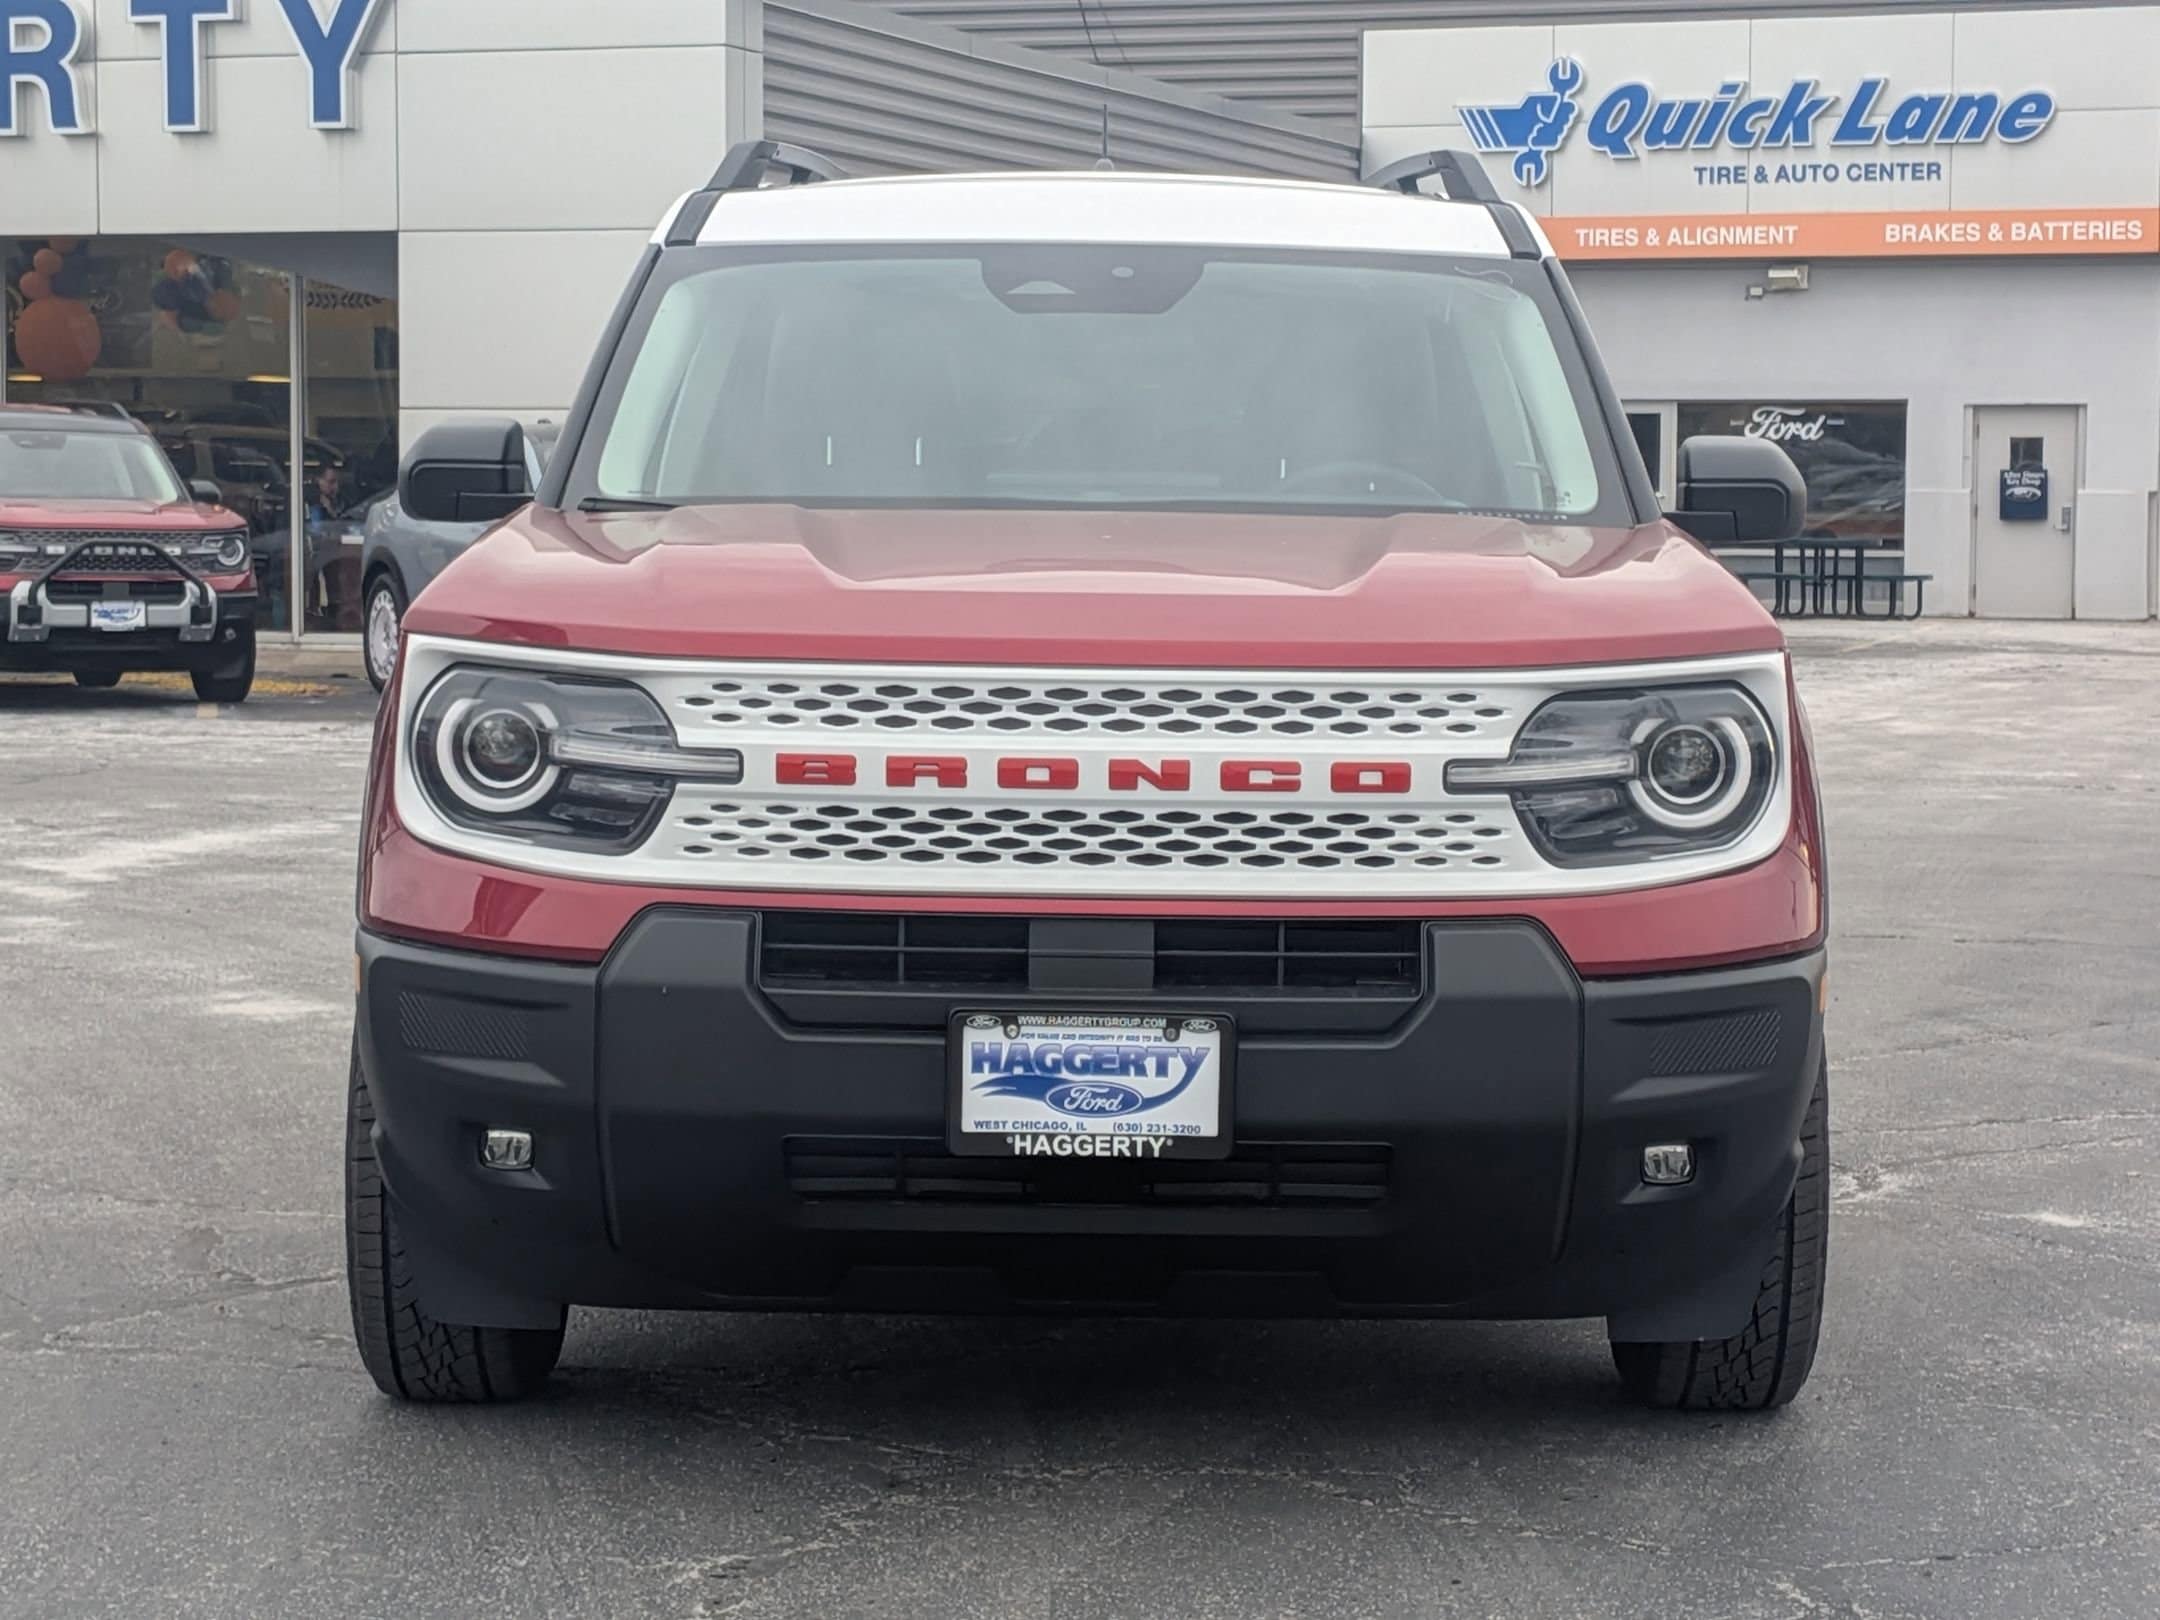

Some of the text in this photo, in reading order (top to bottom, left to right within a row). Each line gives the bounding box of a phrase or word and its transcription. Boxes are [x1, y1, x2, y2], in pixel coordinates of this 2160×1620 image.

[1585, 76, 2055, 159] Quick Lane
[1693, 162, 1942, 185] TIRE & AUTO CENTER
[1574, 225, 1798, 247] TIRES & ALIGNMENT
[1884, 219, 2143, 243] BRAKES & BATTERIES
[1743, 406, 1826, 441] Ford
[775, 752, 1412, 793] BRONCO
[1017, 1015, 1167, 1028] WWW.HAGGERTYGROUP.COM
[971, 1042, 1211, 1079] HAGGERTY
[1063, 1085, 1125, 1113] Ford
[973, 1120, 1202, 1134] WEST CHICAGO, IL (630) 231-3200
[1013, 1133, 1167, 1157] HAGGERTY
